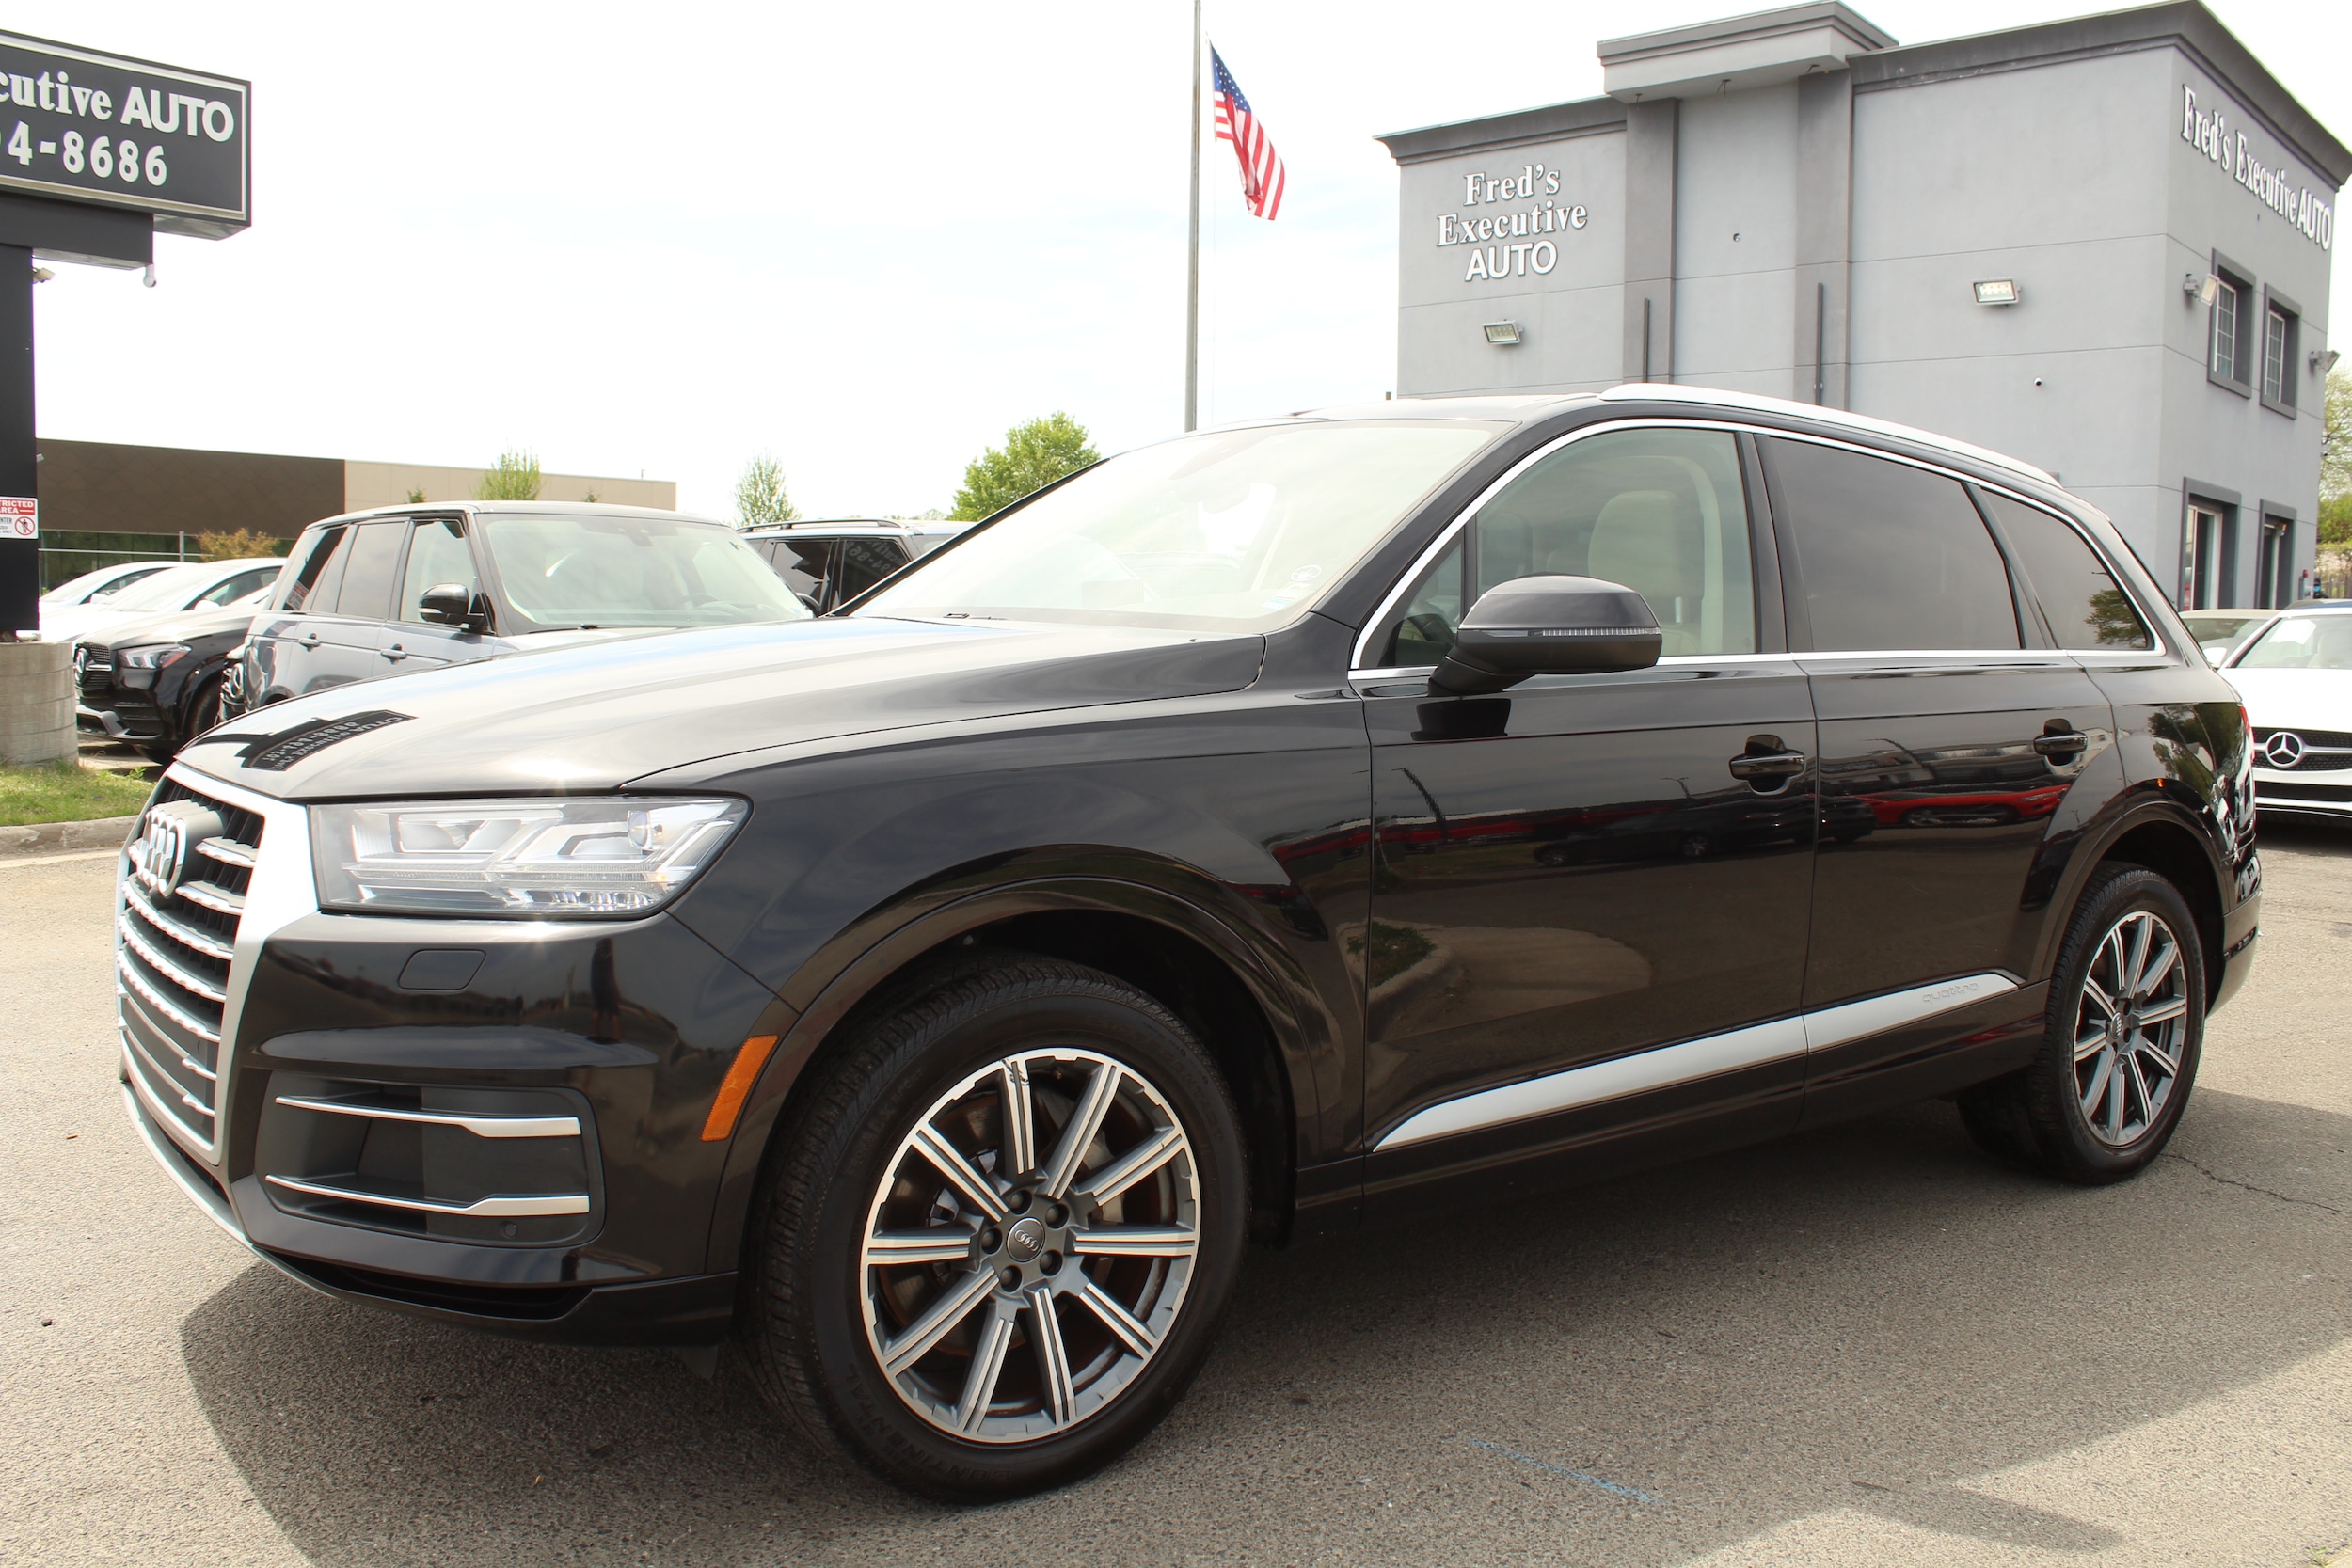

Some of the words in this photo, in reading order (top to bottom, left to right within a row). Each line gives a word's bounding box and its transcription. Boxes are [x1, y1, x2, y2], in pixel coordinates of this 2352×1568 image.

[120, 86, 234, 142] AUTO
[0, 120, 167, 186] 4-8686
[2181, 83, 2231, 172] Fred's
[2234, 129, 2296, 224] Executive
[2296, 186, 2332, 251] AUTO
[1463, 163, 1561, 206] Fred's
[1437, 199, 1587, 247] Executive
[1465, 240, 1558, 282] AUTO
[1922, 982, 1979, 1005] quattro
[845, 1363, 1013, 1483] CONTINENTAL
